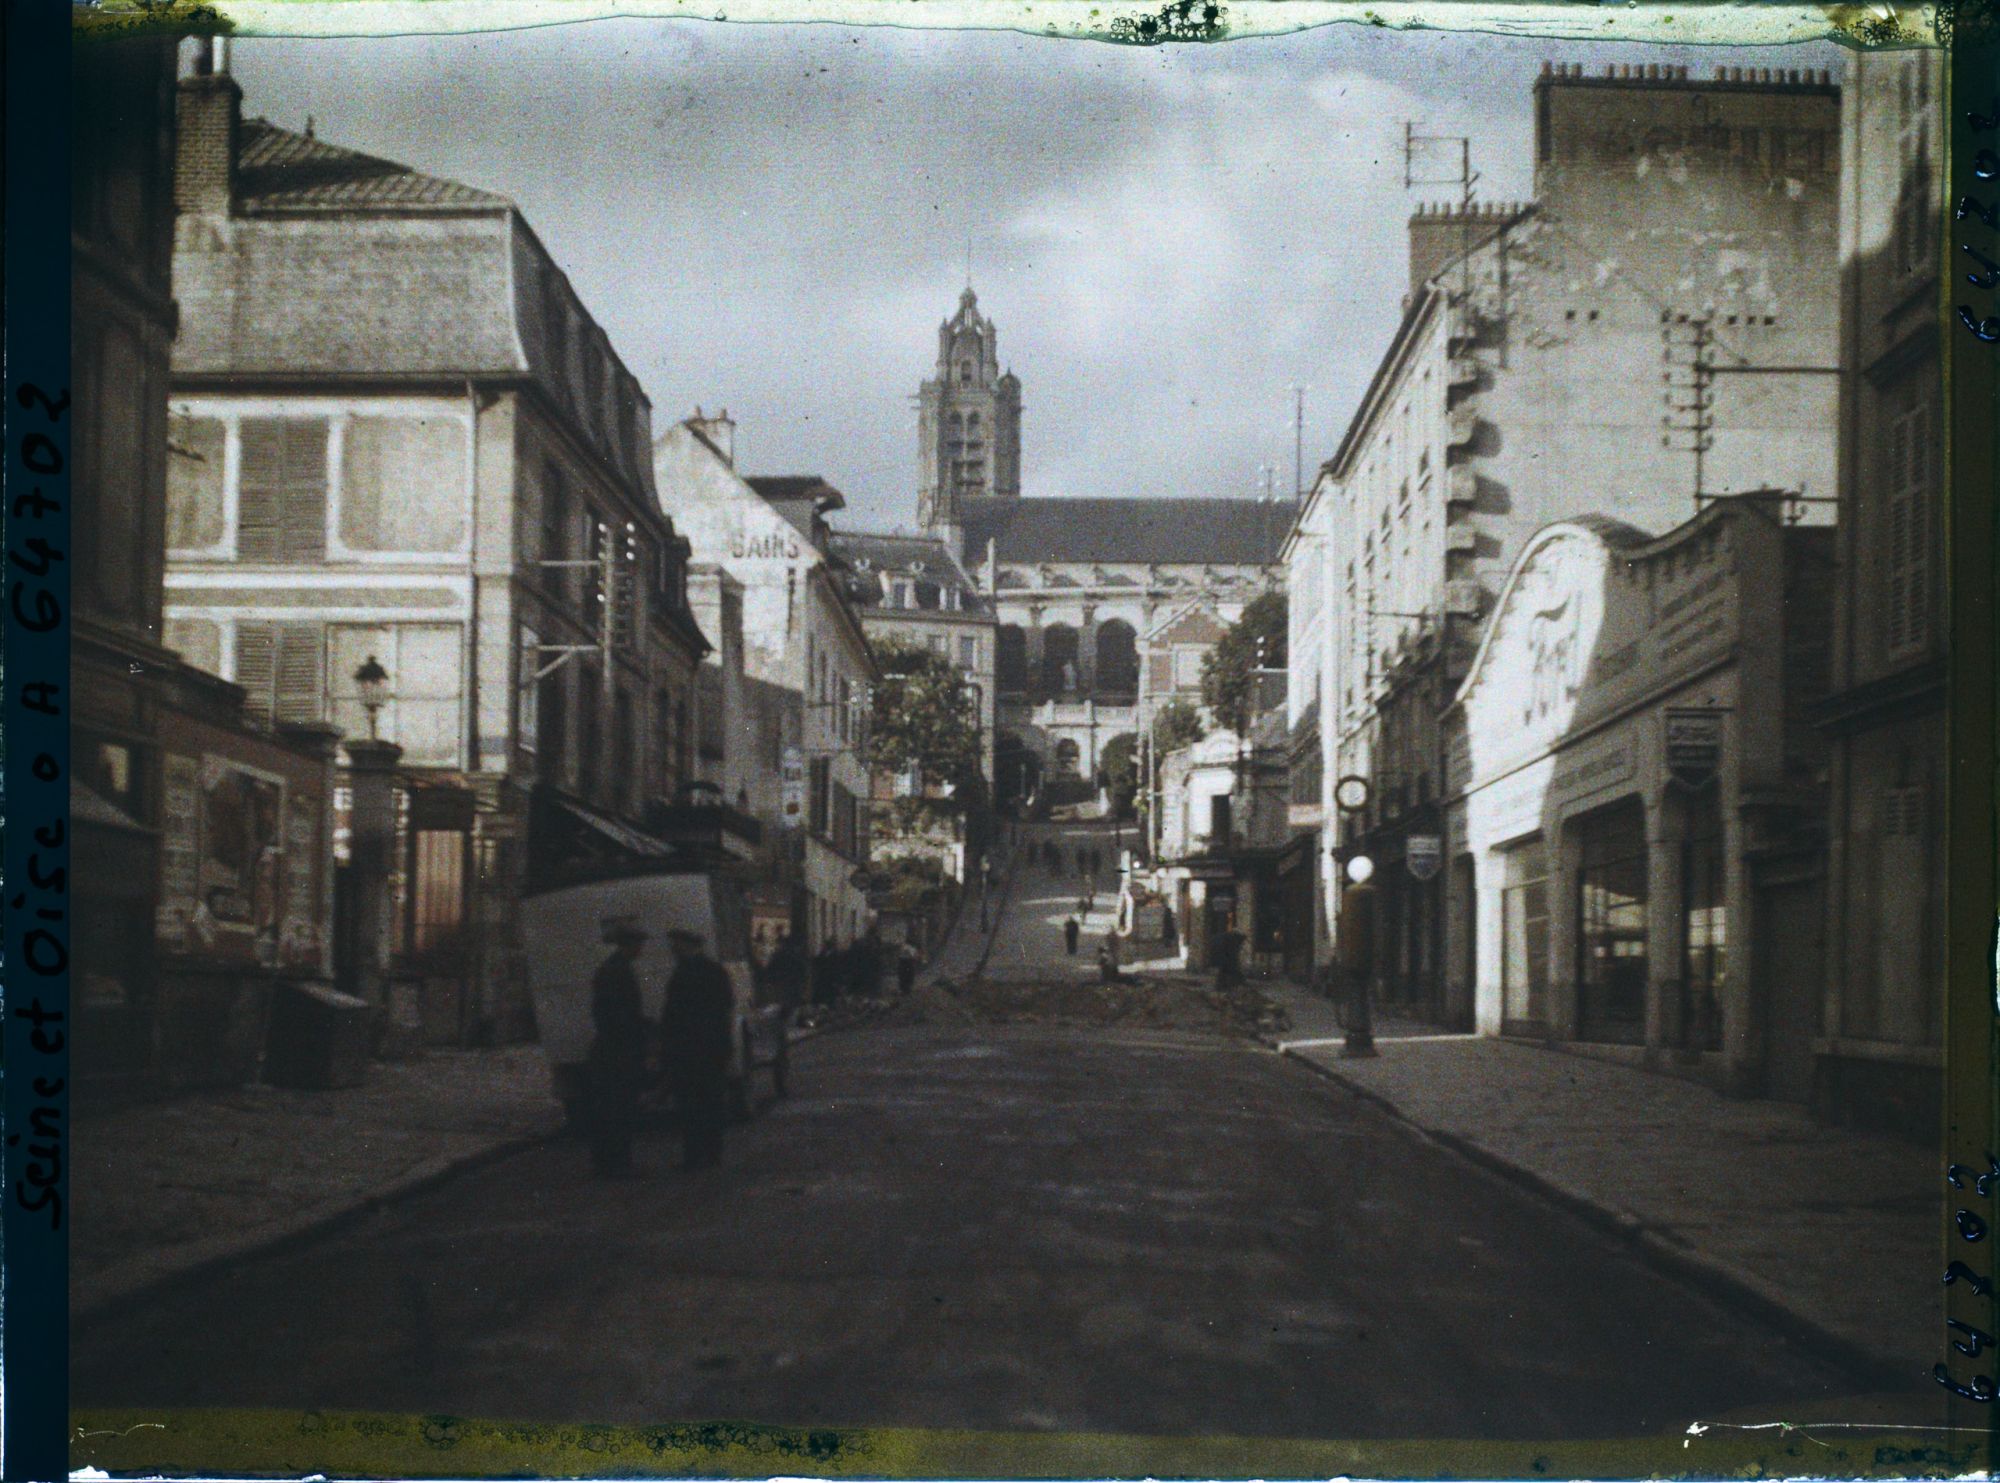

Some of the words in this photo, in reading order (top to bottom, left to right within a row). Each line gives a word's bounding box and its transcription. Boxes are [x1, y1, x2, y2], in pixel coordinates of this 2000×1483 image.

[9, 382, 71, 632] 64702
[21, 680, 60, 715] A
[11, 818, 68, 976] Oise
[14, 998, 64, 1054] et
[8, 1076, 64, 1231] Seine
